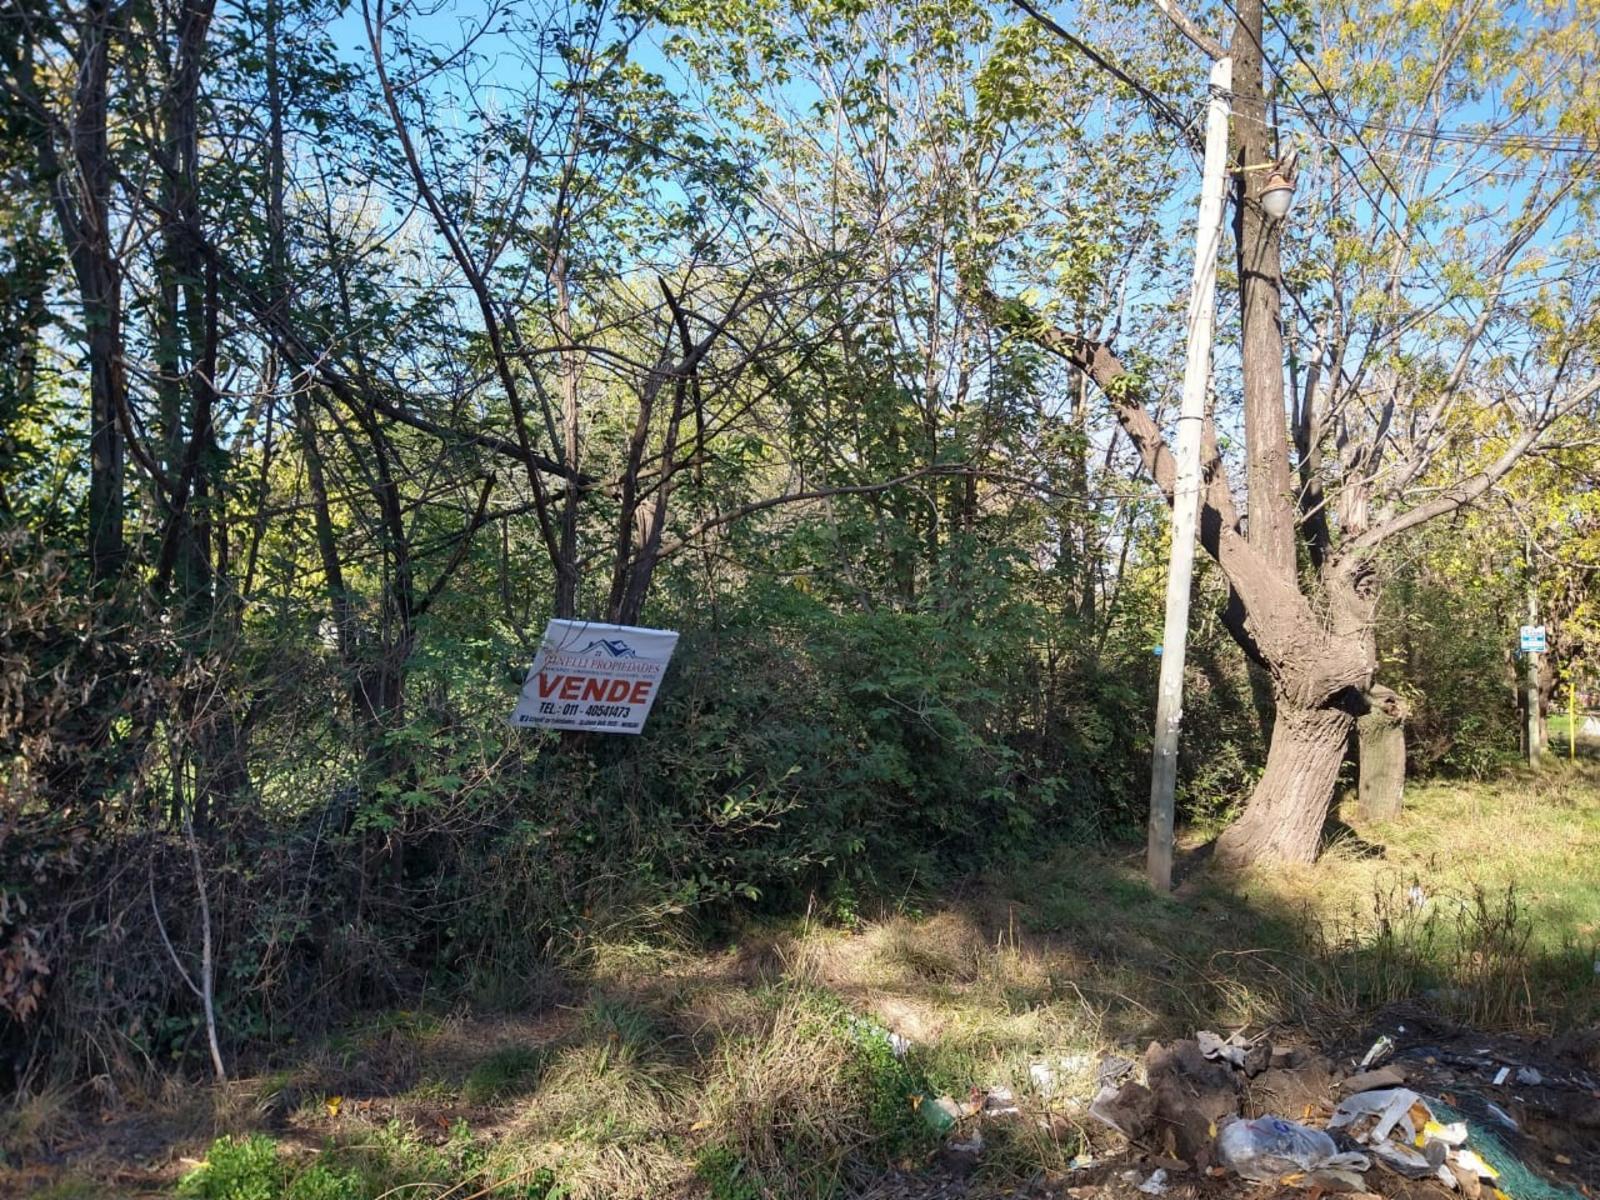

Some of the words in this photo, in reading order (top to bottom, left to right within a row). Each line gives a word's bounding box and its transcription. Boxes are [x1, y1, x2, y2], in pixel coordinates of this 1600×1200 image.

[590, 659, 661, 673] PROPIEDADES
[538, 672, 653, 704] VENDE
[562, 703, 579, 716] 011
[585, 704, 631, 719] 40541473
